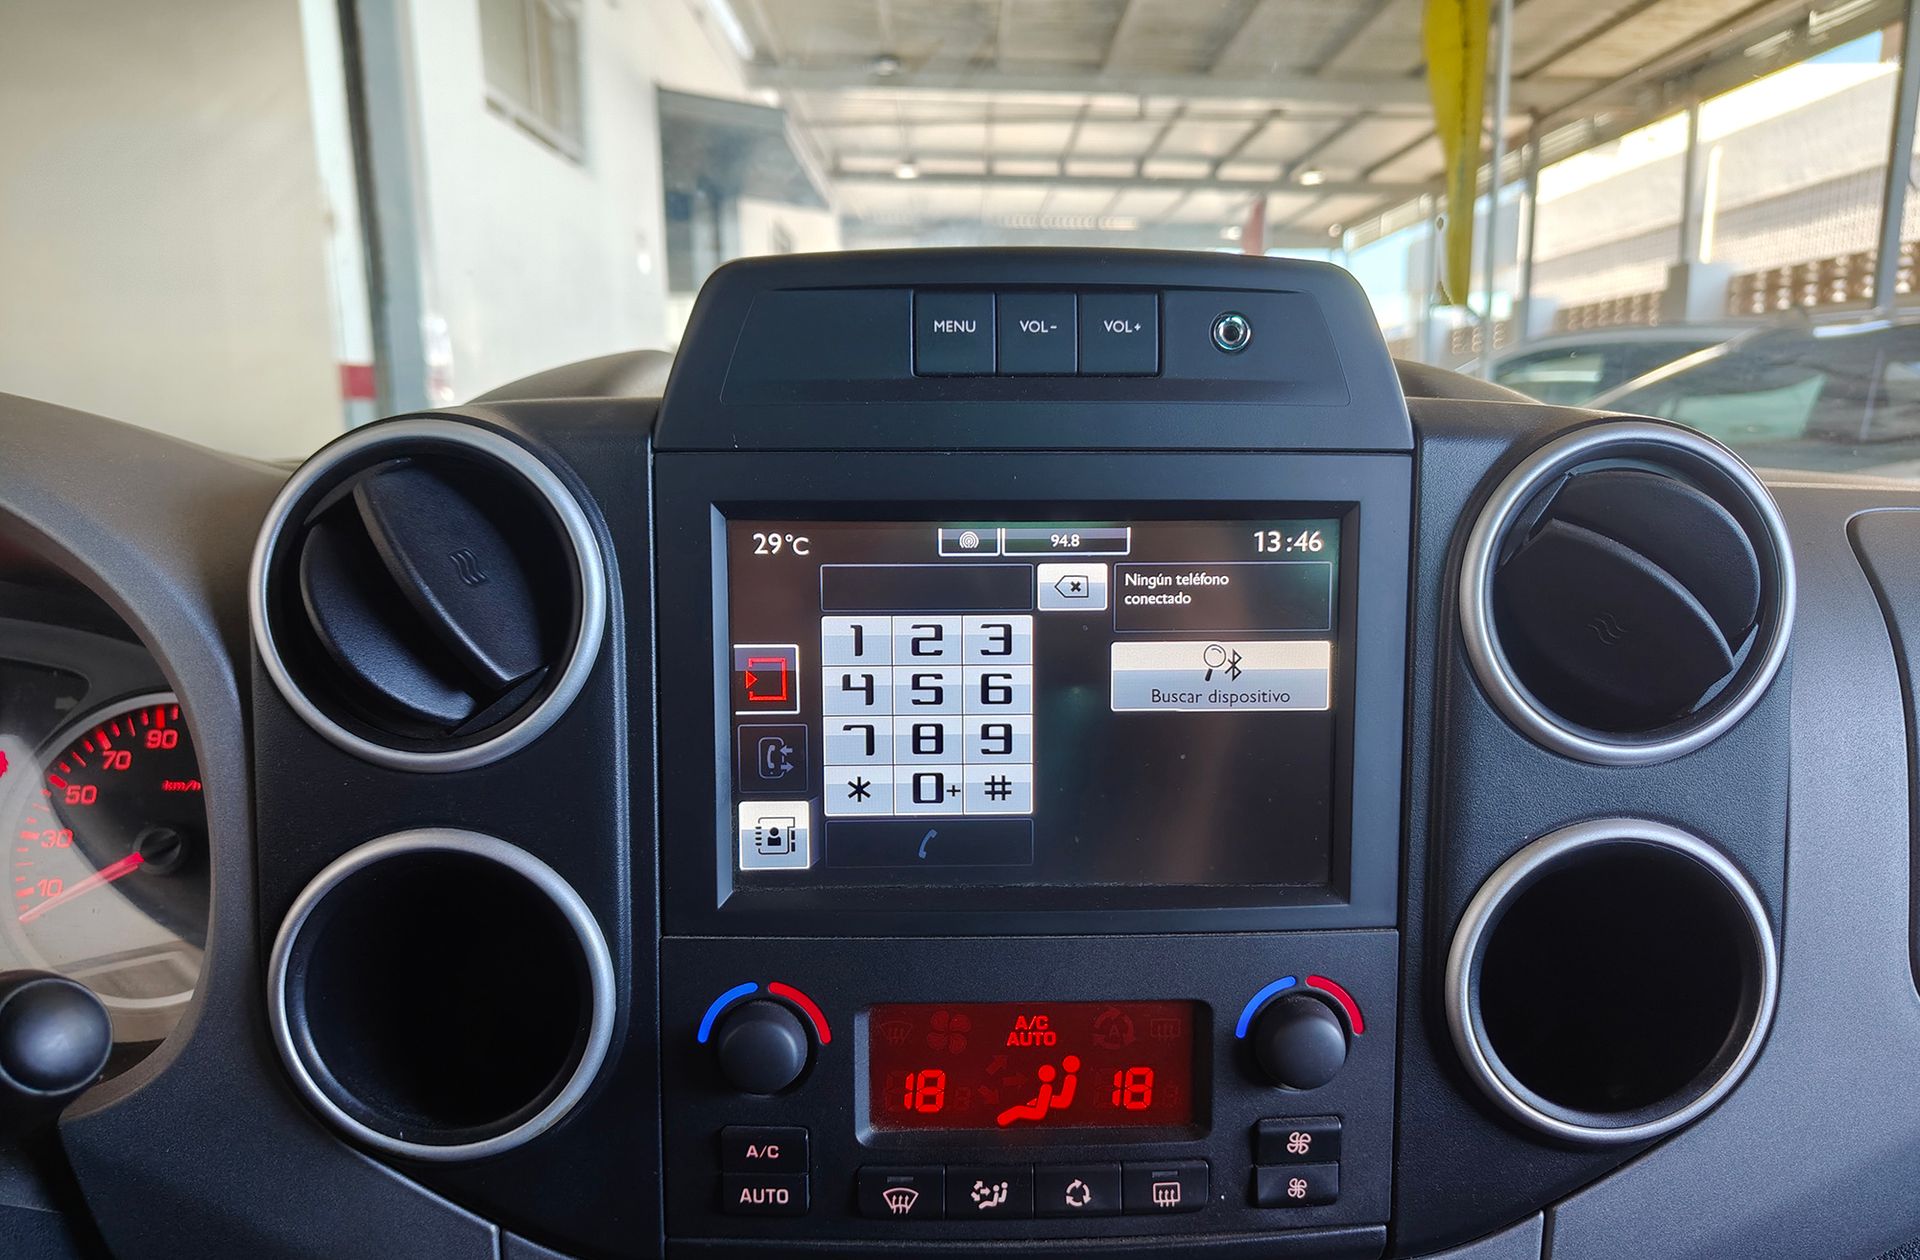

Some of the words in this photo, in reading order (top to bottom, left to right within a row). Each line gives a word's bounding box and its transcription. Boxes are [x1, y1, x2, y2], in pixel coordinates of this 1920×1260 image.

[933, 320, 977, 333] MENU
[1103, 320, 1141, 333] VOL+
[752, 532, 811, 556] 29°C
[1050, 534, 1081, 548] 94.8
[1253, 530, 1323, 553] 13:46
[1124, 571, 1173, 590] Ningún
[1175, 571, 1230, 586] teléfono
[1124, 591, 1192, 605] conectado
[850, 624, 863, 657] 1
[911, 624, 944, 657] 2
[980, 623, 1013, 656] 3
[841, 673, 875, 706] 4
[911, 673, 944, 706] 5
[980, 673, 1013, 705] 6
[1150, 688, 1203, 704] Buscar
[1207, 688, 1291, 708] dispositivo
[146, 729, 178, 749] 90
[842, 724, 875, 757] 7
[911, 723, 944, 755] 8
[980, 723, 1013, 755] 9
[102, 750, 132, 770] 70
[64, 785, 97, 804] 50
[162, 779, 202, 792] km/h
[41, 829, 75, 849] 30
[37, 878, 65, 897] 10
[1014, 1015, 1049, 1031] A/C
[1006, 1031, 1057, 1048] AUTO
[903, 1069, 947, 1113] 18
[1111, 1066, 1154, 1110] 18
[745, 1144, 780, 1160] A/C
[738, 1187, 790, 1205] AUTO
